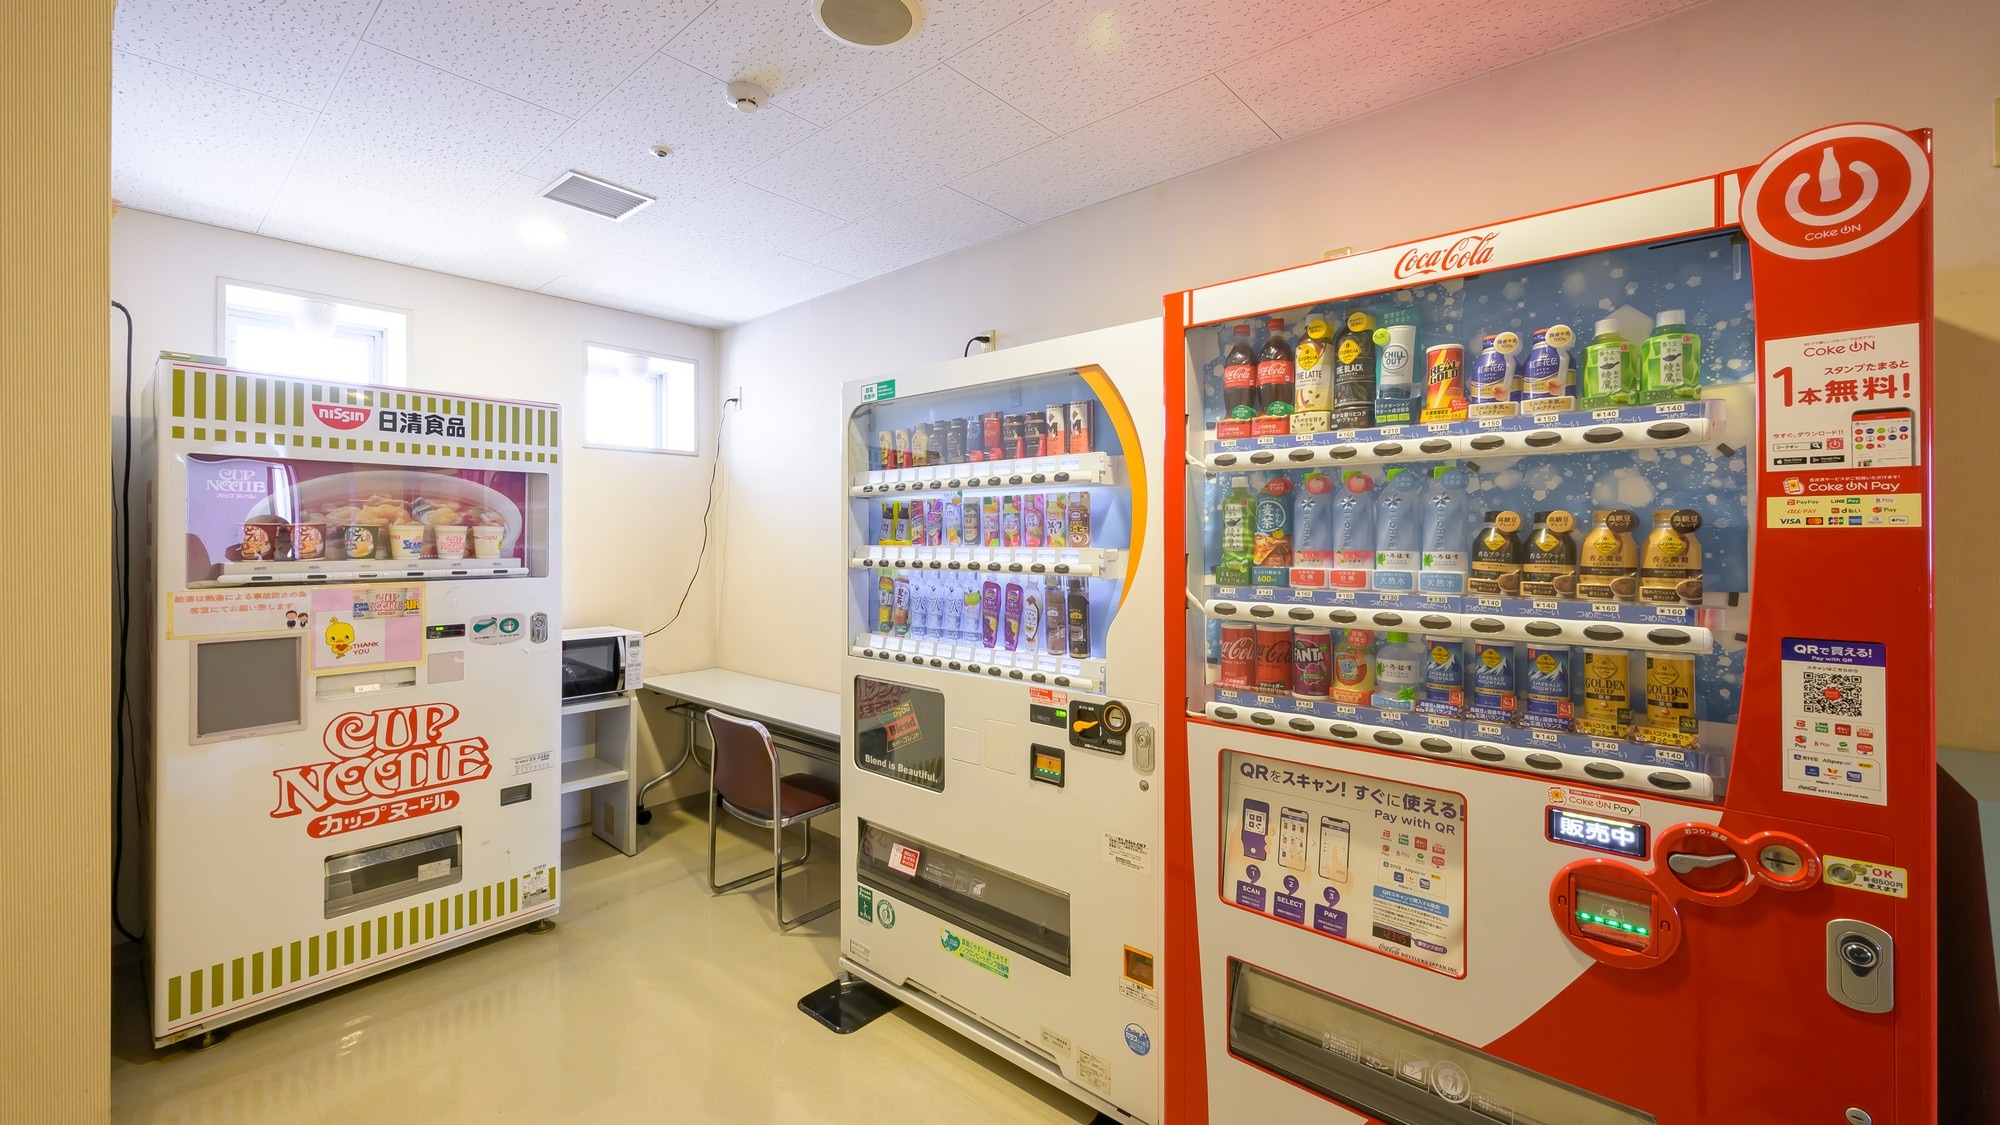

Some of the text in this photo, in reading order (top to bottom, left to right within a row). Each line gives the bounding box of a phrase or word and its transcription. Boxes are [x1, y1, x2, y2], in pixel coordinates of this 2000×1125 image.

[1805, 229, 1838, 241] Coke
[1394, 231, 1501, 279] Coca-Cola
[1803, 345, 1846, 358] Coke
[1346, 364, 1364, 373] BLACK
[1430, 360, 1459, 374] REAL
[1824, 360, 1910, 376] スタンプたまると
[1305, 370, 1322, 379] LATTE
[1430, 369, 1458, 385] GOLD
[1772, 366, 1911, 408] 1本無料!
[379, 410, 466, 438] 日清食品
[1808, 483, 1844, 492] Coke
[1871, 482, 1900, 492] Pay
[1262, 504, 1274, 529] 麦茶
[1530, 552, 1565, 560] 香るブラック
[1380, 578, 1406, 586] 天然水
[1427, 579, 1455, 588] 天然水
[352, 648, 370, 656] YOU
[1794, 644, 1872, 658] QRで買える!
[1585, 678, 1626, 690] GOLDEN
[1647, 684, 1688, 698] GOLDEN
[892, 706, 911, 718] DyDo
[323, 702, 460, 762] CUP
[888, 717, 916, 736] Blend
[864, 754, 938, 784] Blend is Beautiful.
[270, 736, 493, 819] NOODLE
[1240, 762, 1464, 822] QRをスキャン! すぐに使える!
[1569, 796, 1594, 807] Coke
[1614, 804, 1634, 815] Pay
[318, 794, 454, 837] カップヌードル
[1374, 809, 1456, 836] Pay with QR
[1560, 817, 1635, 848] 販売中
[1872, 868, 1893, 880] OK
[1242, 886, 1261, 896] SCAN
[1868, 883, 1900, 894] 使えます
[1276, 896, 1303, 909] SELECT
[1329, 892, 1334, 900] 3
[1381, 889, 1440, 911] QRスキャンで購入する場合
[1324, 910, 1338, 920] PAY
[1401, 953, 1429, 965] BOTTLERS
[1429, 961, 1447, 970] JAPAN
